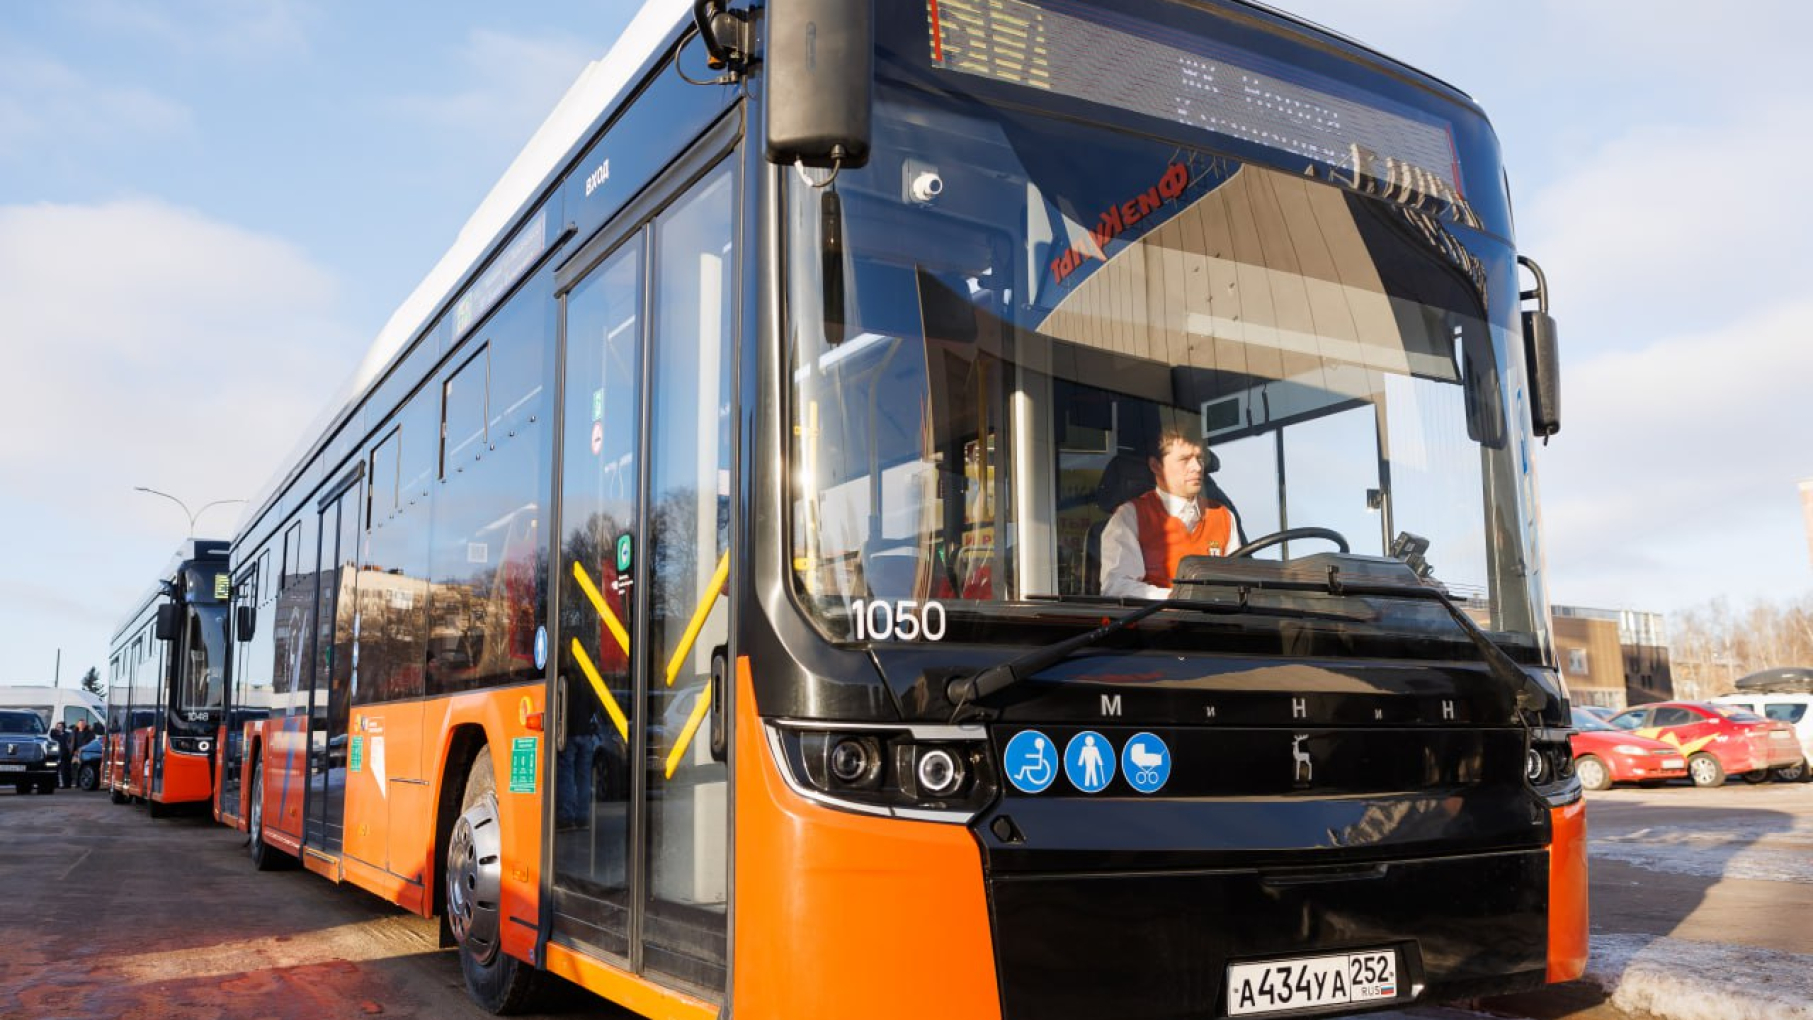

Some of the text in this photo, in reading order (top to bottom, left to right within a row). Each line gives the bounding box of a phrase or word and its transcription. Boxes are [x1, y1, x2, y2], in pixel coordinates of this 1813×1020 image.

[585, 158, 610, 197] ВХОД
[852, 599, 946, 641] 1050
[187, 712, 209, 722] 1048
[1239, 955, 1389, 1008] А434УА 252
[1361, 985, 1381, 997] RUS
